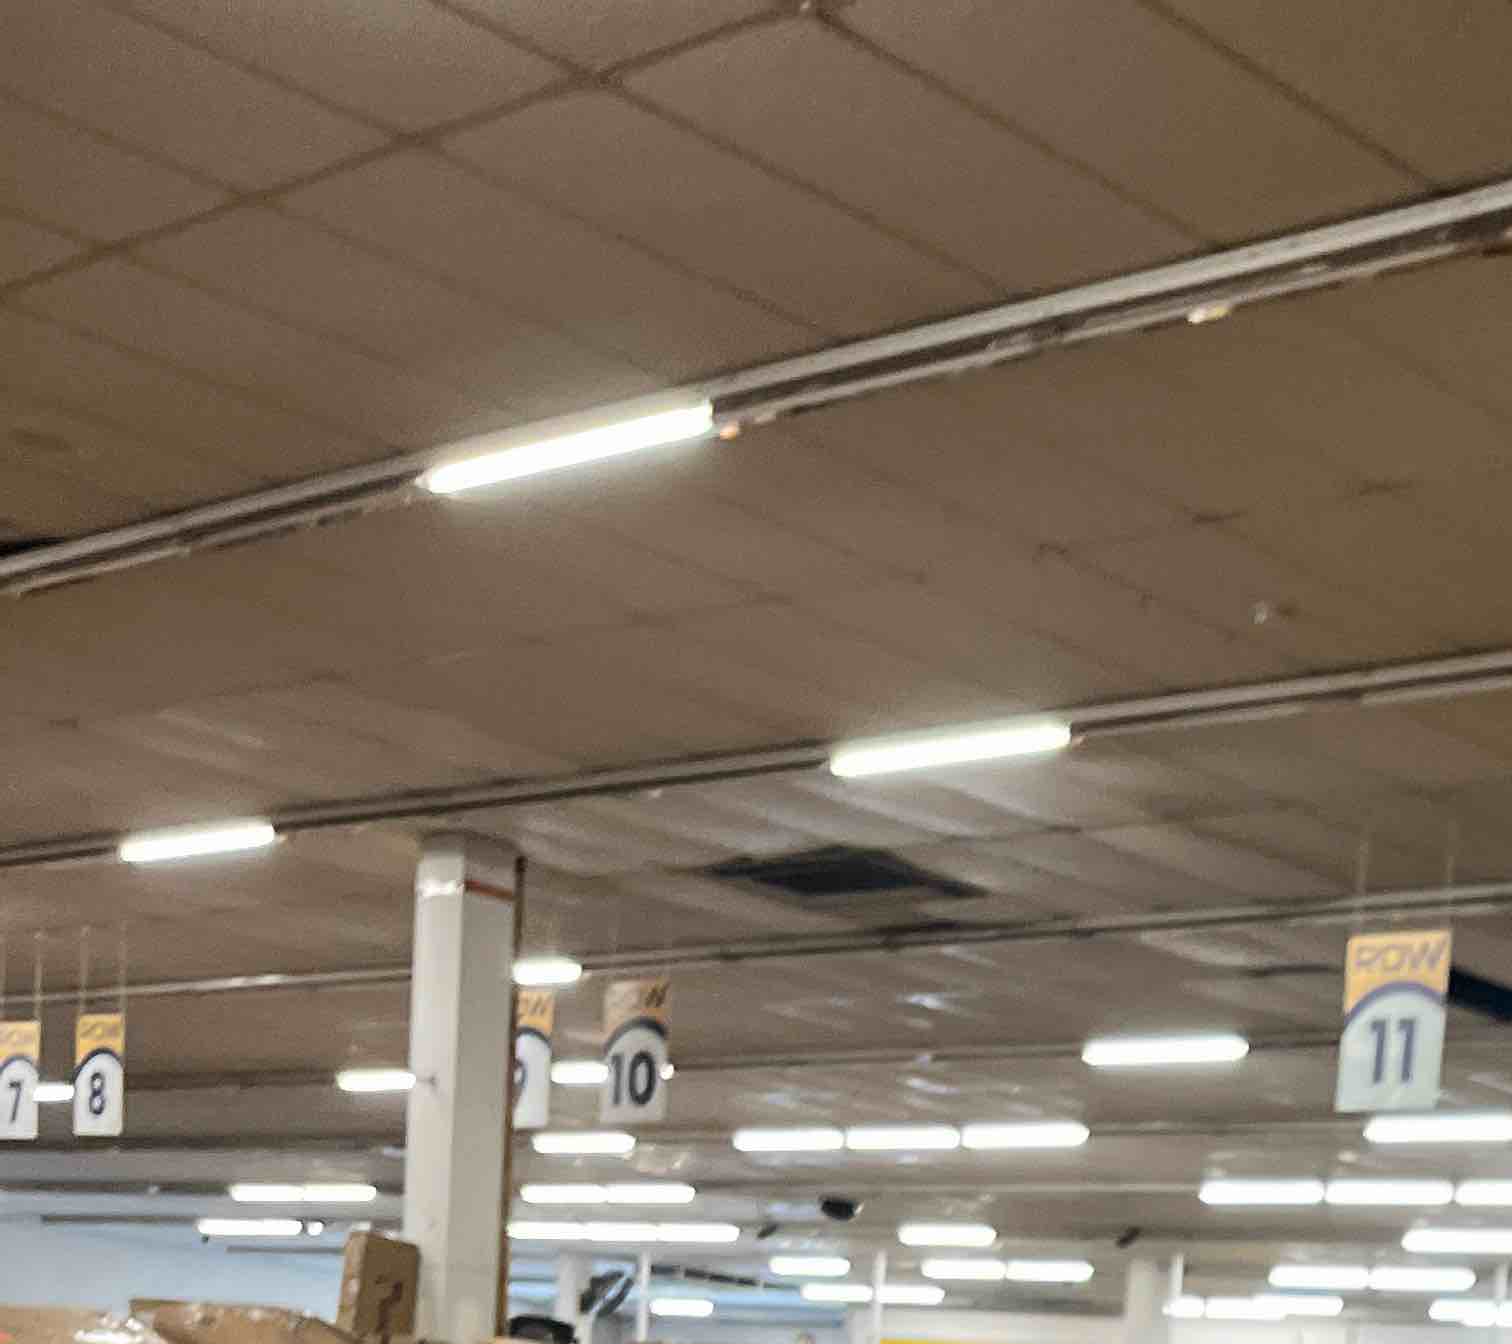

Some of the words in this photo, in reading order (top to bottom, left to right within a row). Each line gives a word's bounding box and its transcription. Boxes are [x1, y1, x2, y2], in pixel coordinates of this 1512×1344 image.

[1354, 938, 1447, 972] ROW
[1369, 1018, 1417, 1084] 11
[88, 1071, 106, 1115] 8
[611, 1050, 657, 1107] 10
[8, 1080, 22, 1123] 7
